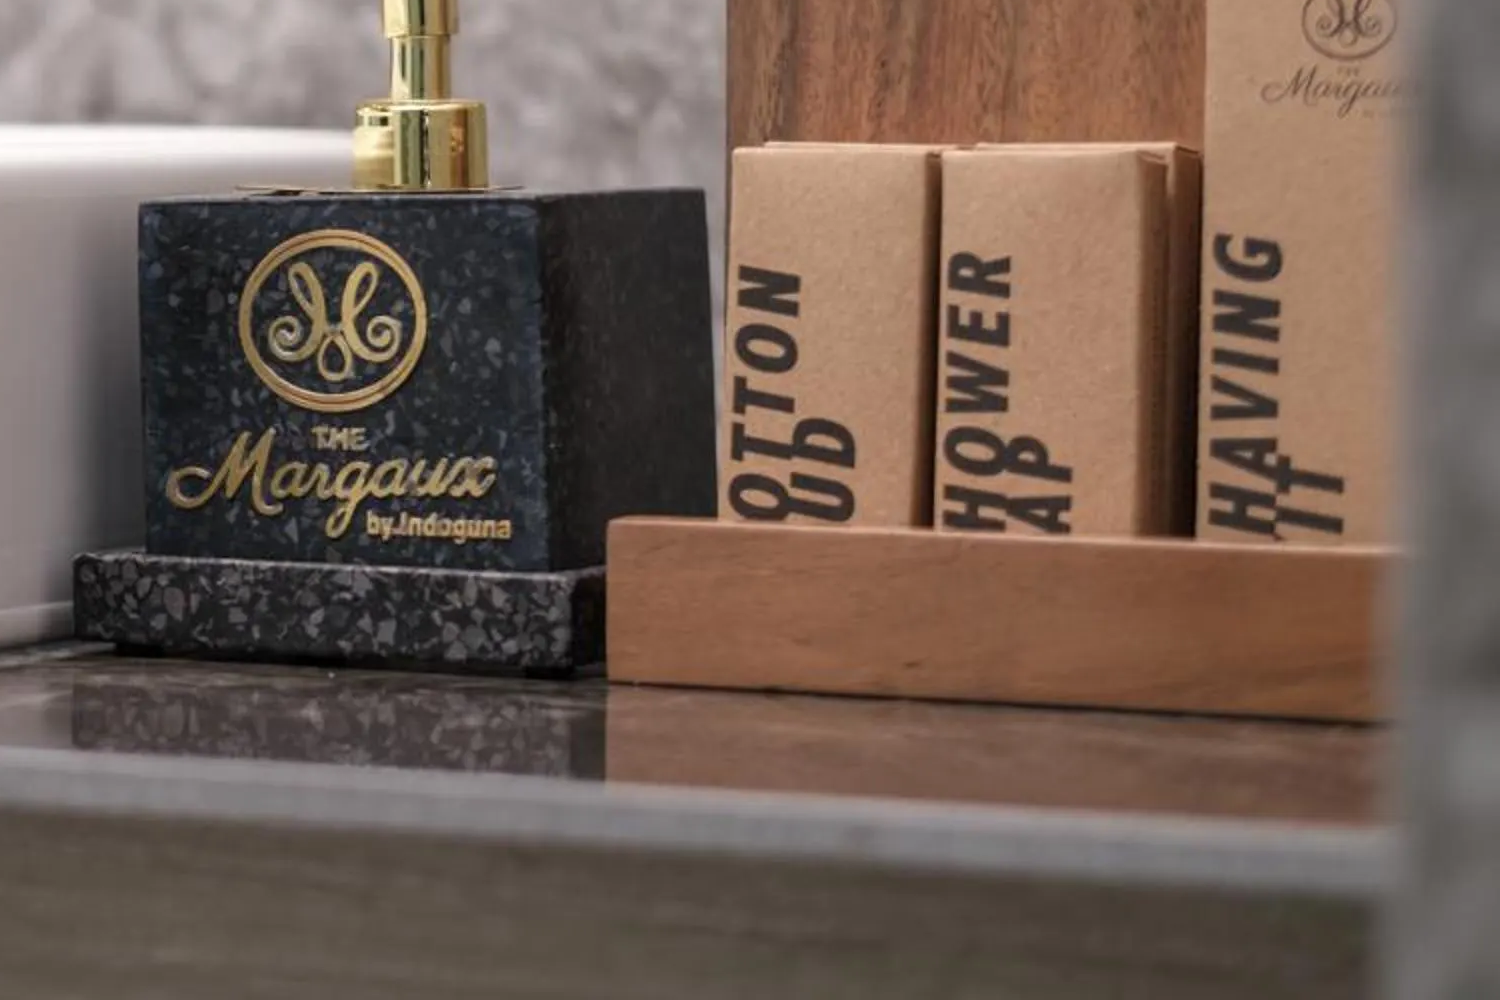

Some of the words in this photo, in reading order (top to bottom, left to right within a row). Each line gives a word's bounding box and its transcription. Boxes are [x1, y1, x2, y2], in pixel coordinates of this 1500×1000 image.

[311, 426, 370, 451] THE
[728, 264, 802, 521] OTTON
[942, 251, 1012, 532] HOWER
[1207, 233, 1284, 536] HAVING
[166, 427, 498, 538] Margaux
[788, 417, 856, 523] UD
[1003, 435, 1072, 534] AP
[1275, 454, 1345, 535] IT
